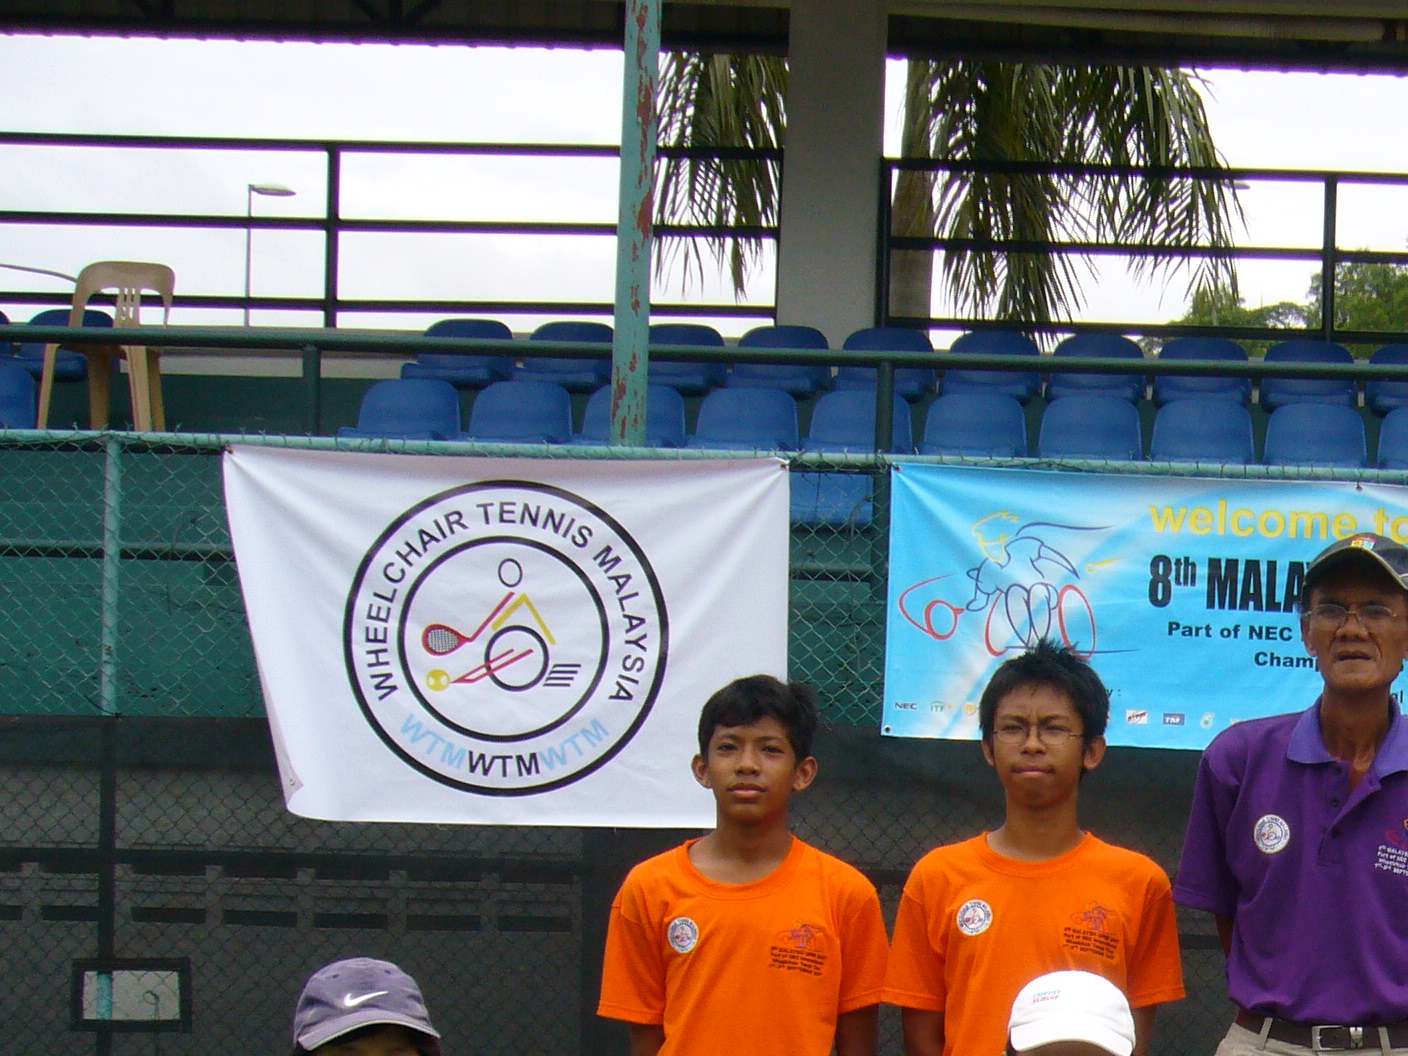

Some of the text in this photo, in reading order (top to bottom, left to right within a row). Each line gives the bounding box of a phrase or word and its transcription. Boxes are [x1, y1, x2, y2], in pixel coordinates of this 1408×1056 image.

[1150, 499, 1357, 540] welcome
[365, 501, 648, 703] WHEELCHAIR TENNIS MALAYSIA
[1148, 554, 1198, 608] 8th
[1206, 557, 1308, 613] MALA
[1167, 621, 1293, 641] Part of NEC
[894, 702, 918, 711] NEC
